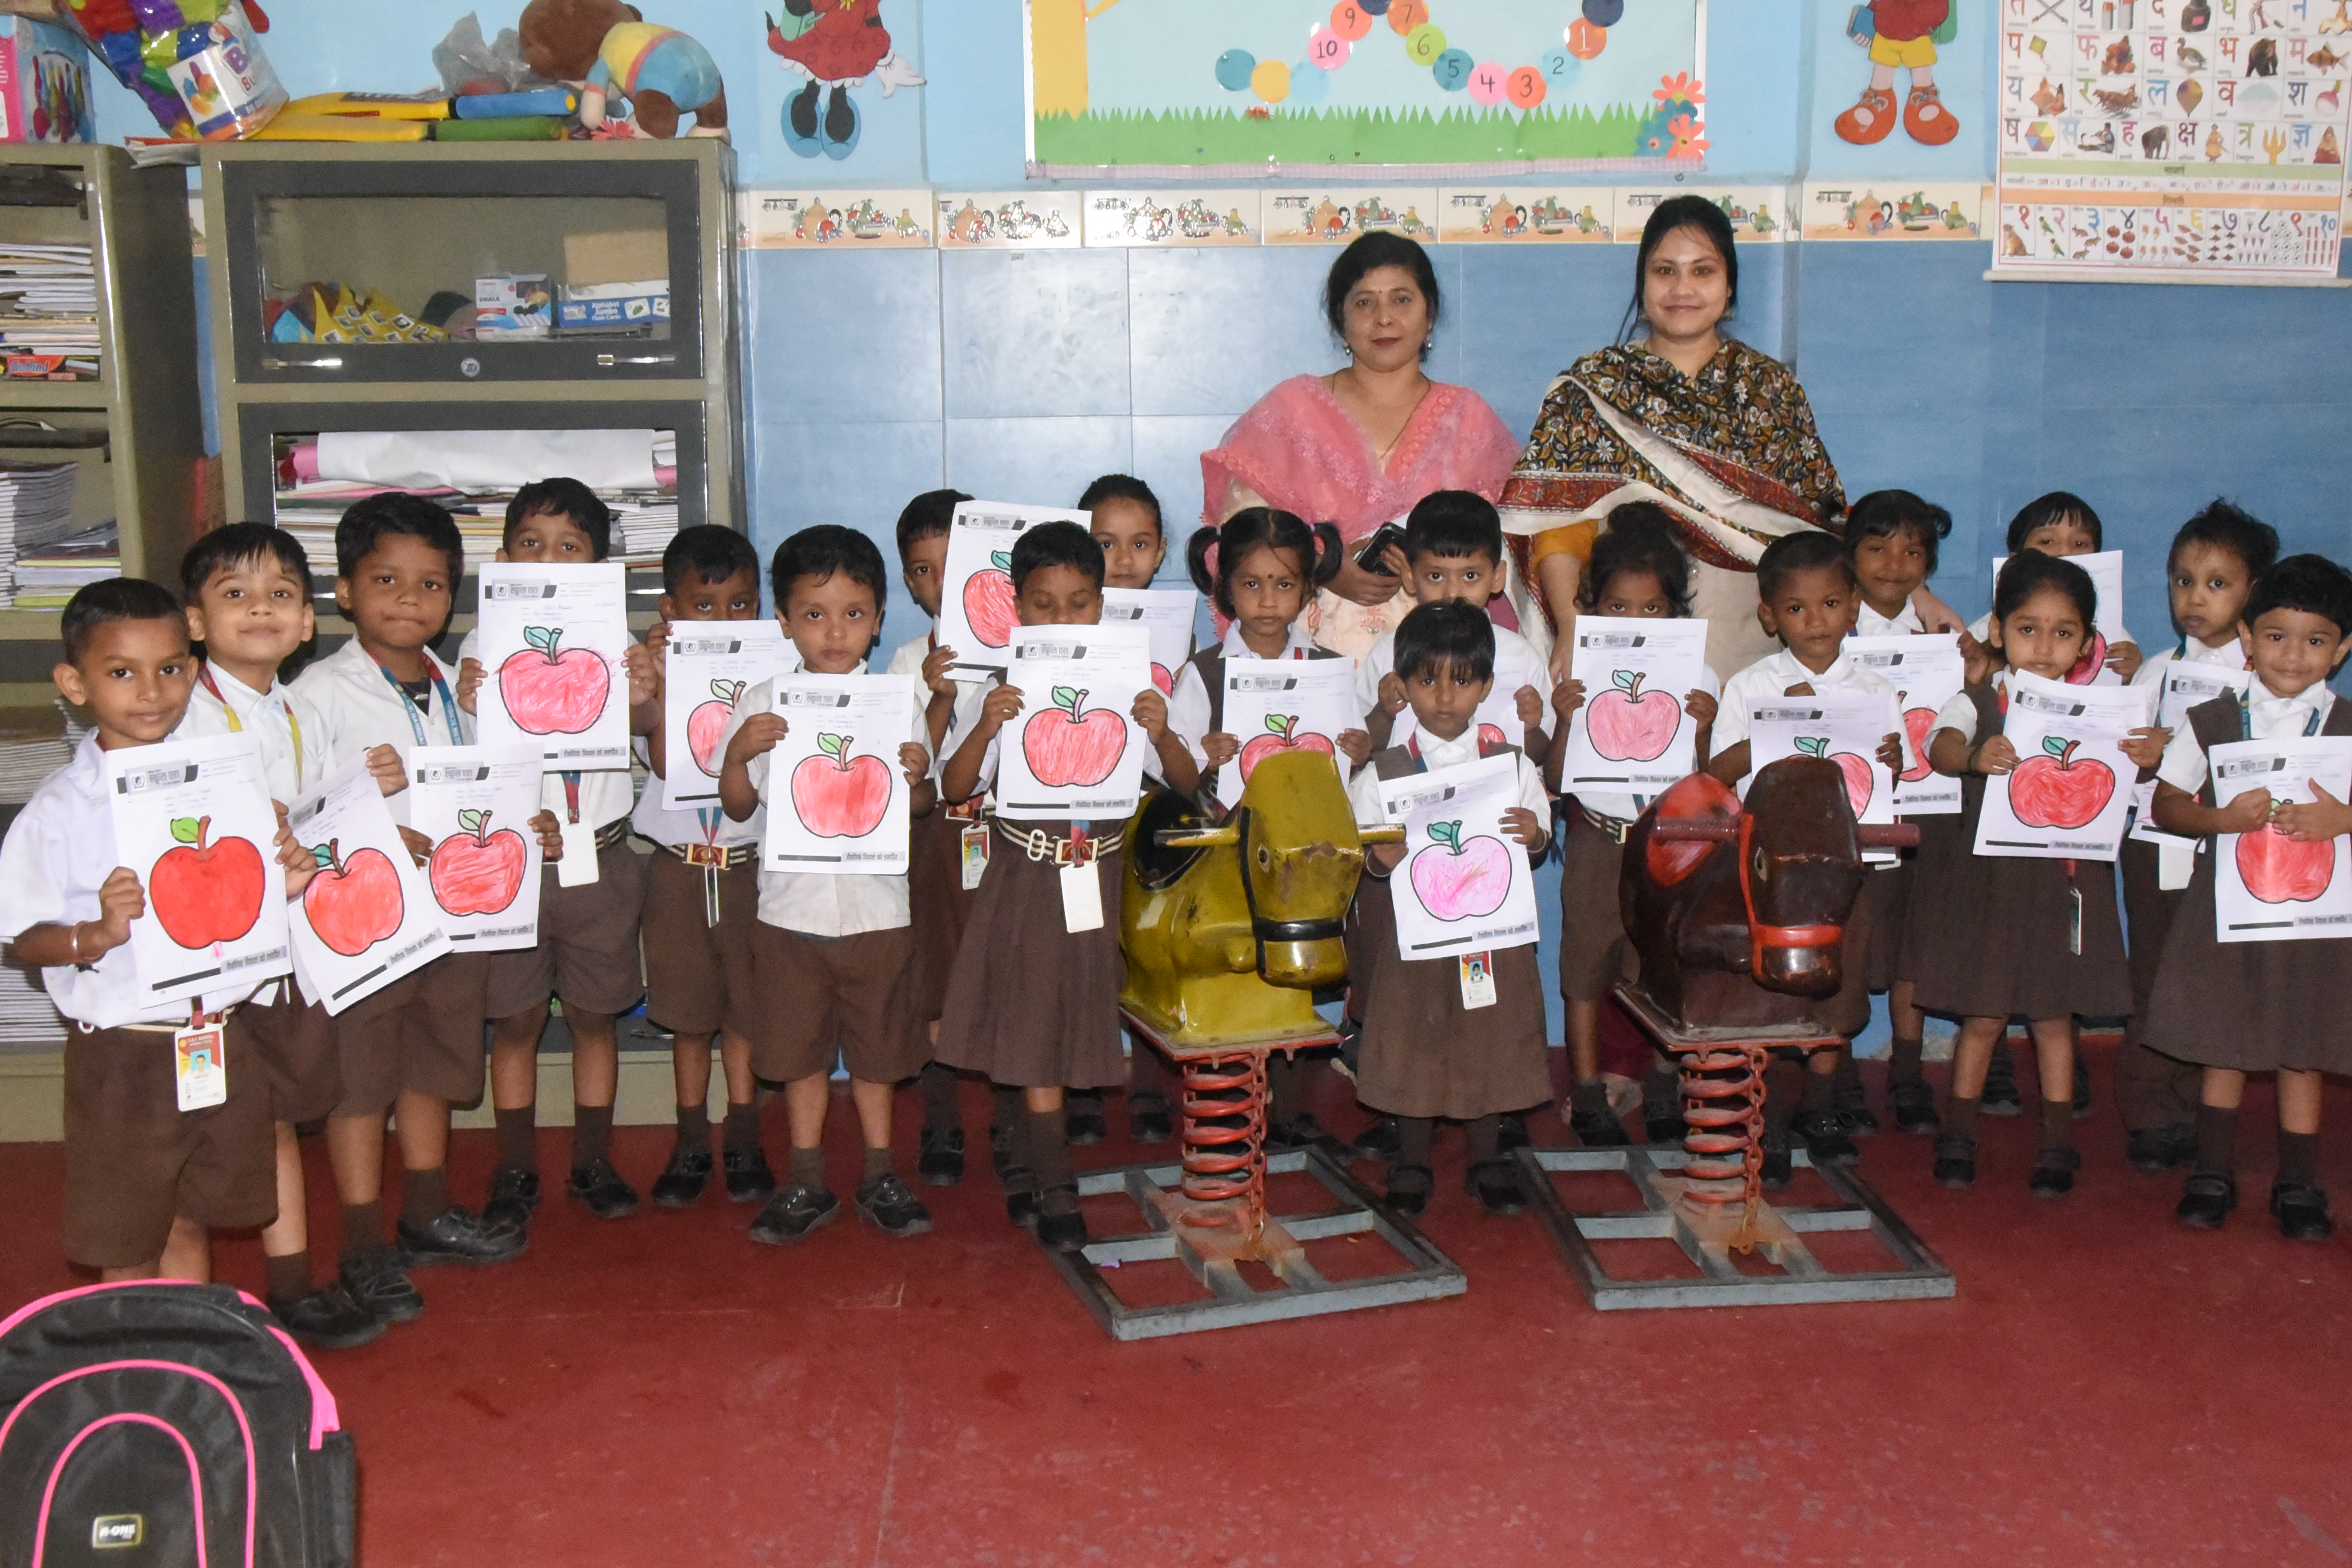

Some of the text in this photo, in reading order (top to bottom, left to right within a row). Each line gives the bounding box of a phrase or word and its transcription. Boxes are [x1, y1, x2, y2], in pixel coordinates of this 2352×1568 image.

[1345, 8, 1355, 29] 9
[1402, 4, 1412, 23] 7
[1317, 40, 1338, 59] 10
[1417, 33, 1430, 56] 6
[1579, 26, 1591, 51] 1
[2007, 33, 2307, 64] प फ ब भ म
[1448, 59, 1460, 78] 5
[1552, 57, 1564, 75] 2
[1481, 74, 1495, 93] 4
[1520, 75, 1533, 97] 3
[2006, 76, 2308, 107] य र ल व श
[2004, 118, 2312, 149] ष स ह क्ष त्र ज्ञ
[2019, 205, 2336, 238] १ २ ३ ४ ५ ६ ७ ८ ९ १०
[592, 301, 620, 310] Alphabet
[446, 700, 462, 745] DERN SCHOOL
